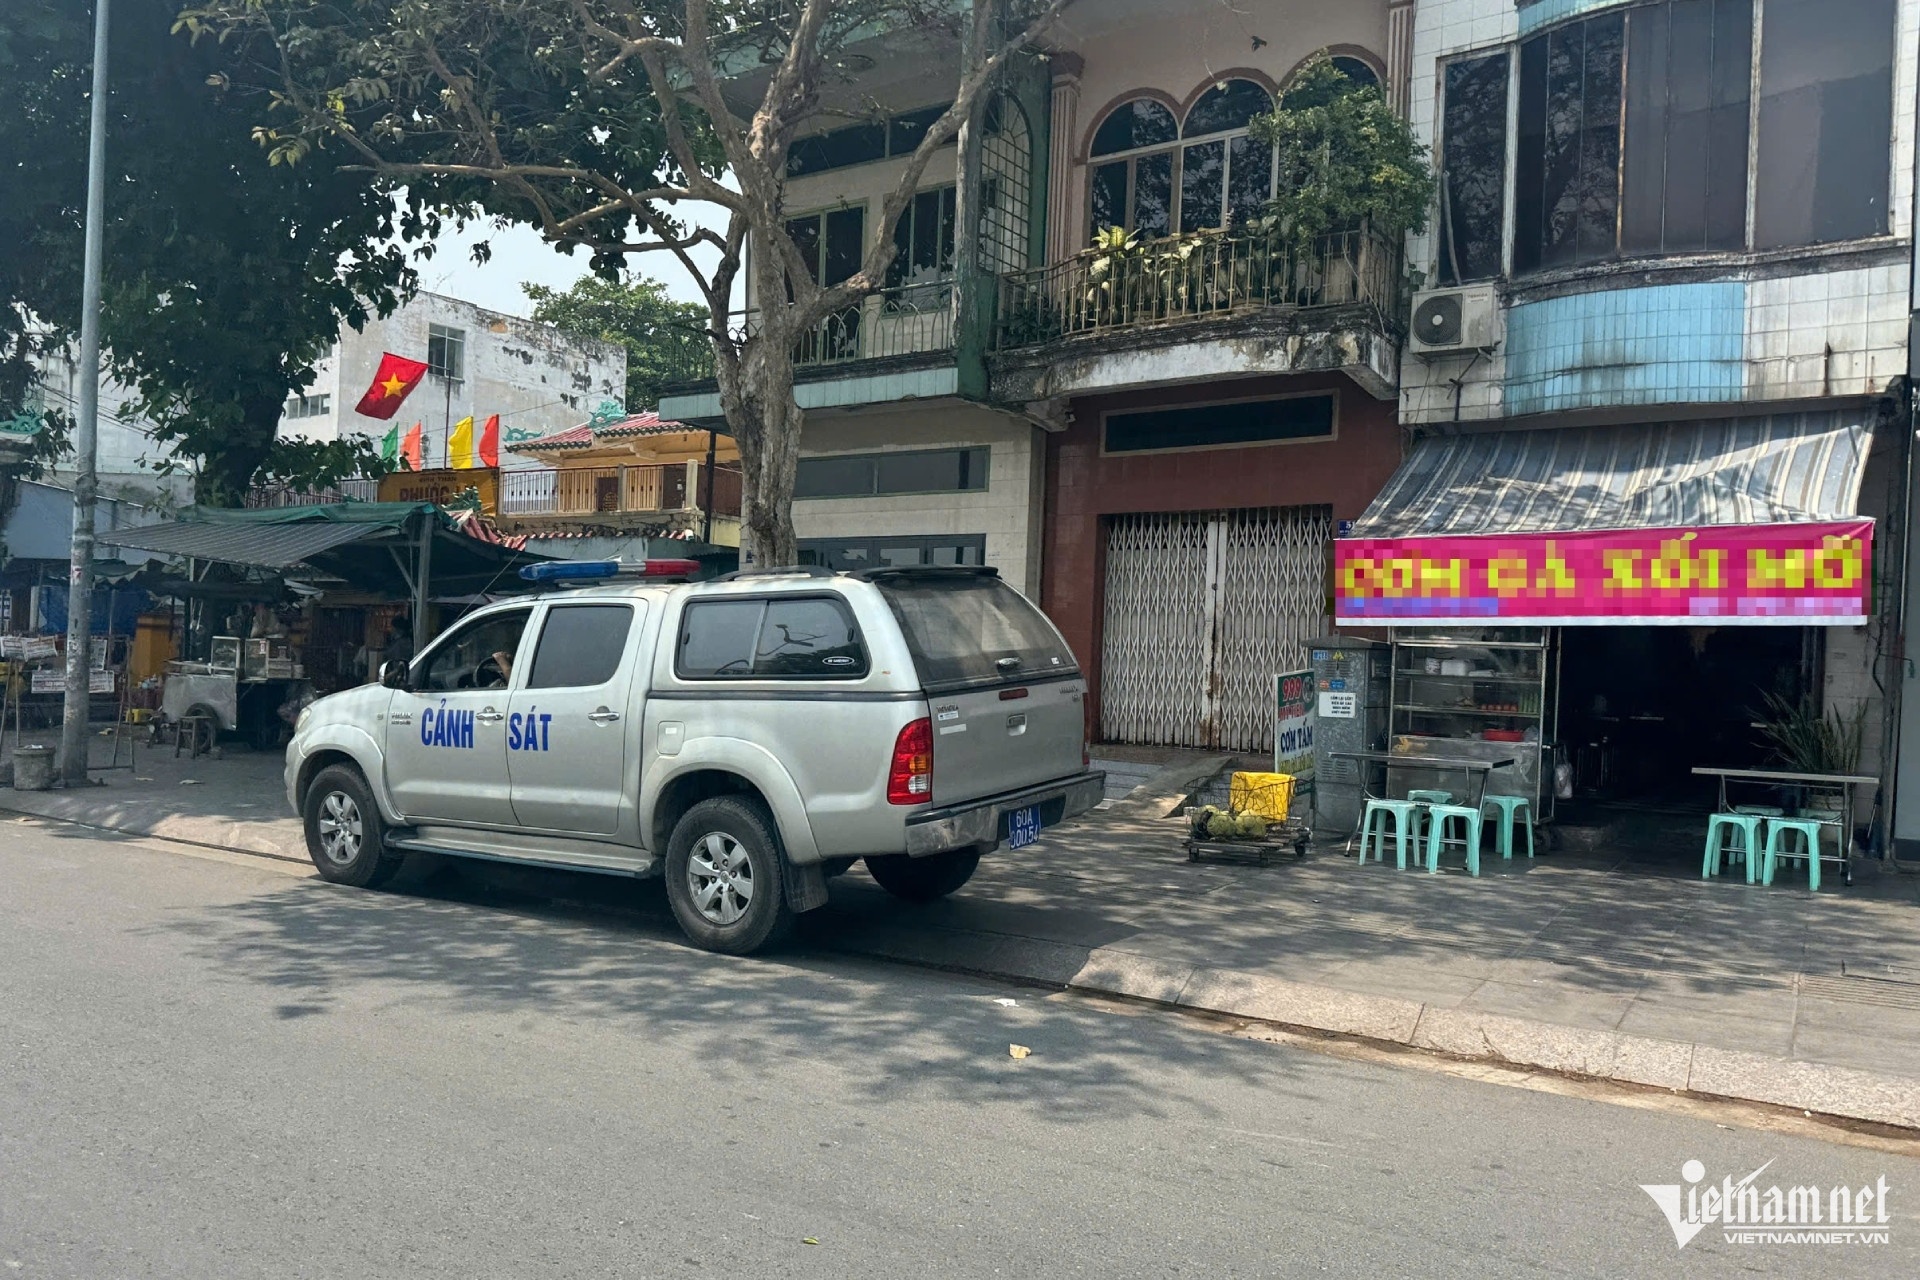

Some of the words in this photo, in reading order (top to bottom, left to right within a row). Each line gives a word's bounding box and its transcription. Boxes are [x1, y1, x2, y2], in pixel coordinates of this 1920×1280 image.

[1282, 677, 1302, 702] 999
[421, 698, 474, 749] CẢNH
[508, 705, 552, 751] SÁT
[1280, 726, 1296, 753] CƠM
[1298, 717, 1313, 749] TẤM
[1016, 807, 1033, 828] 60A
